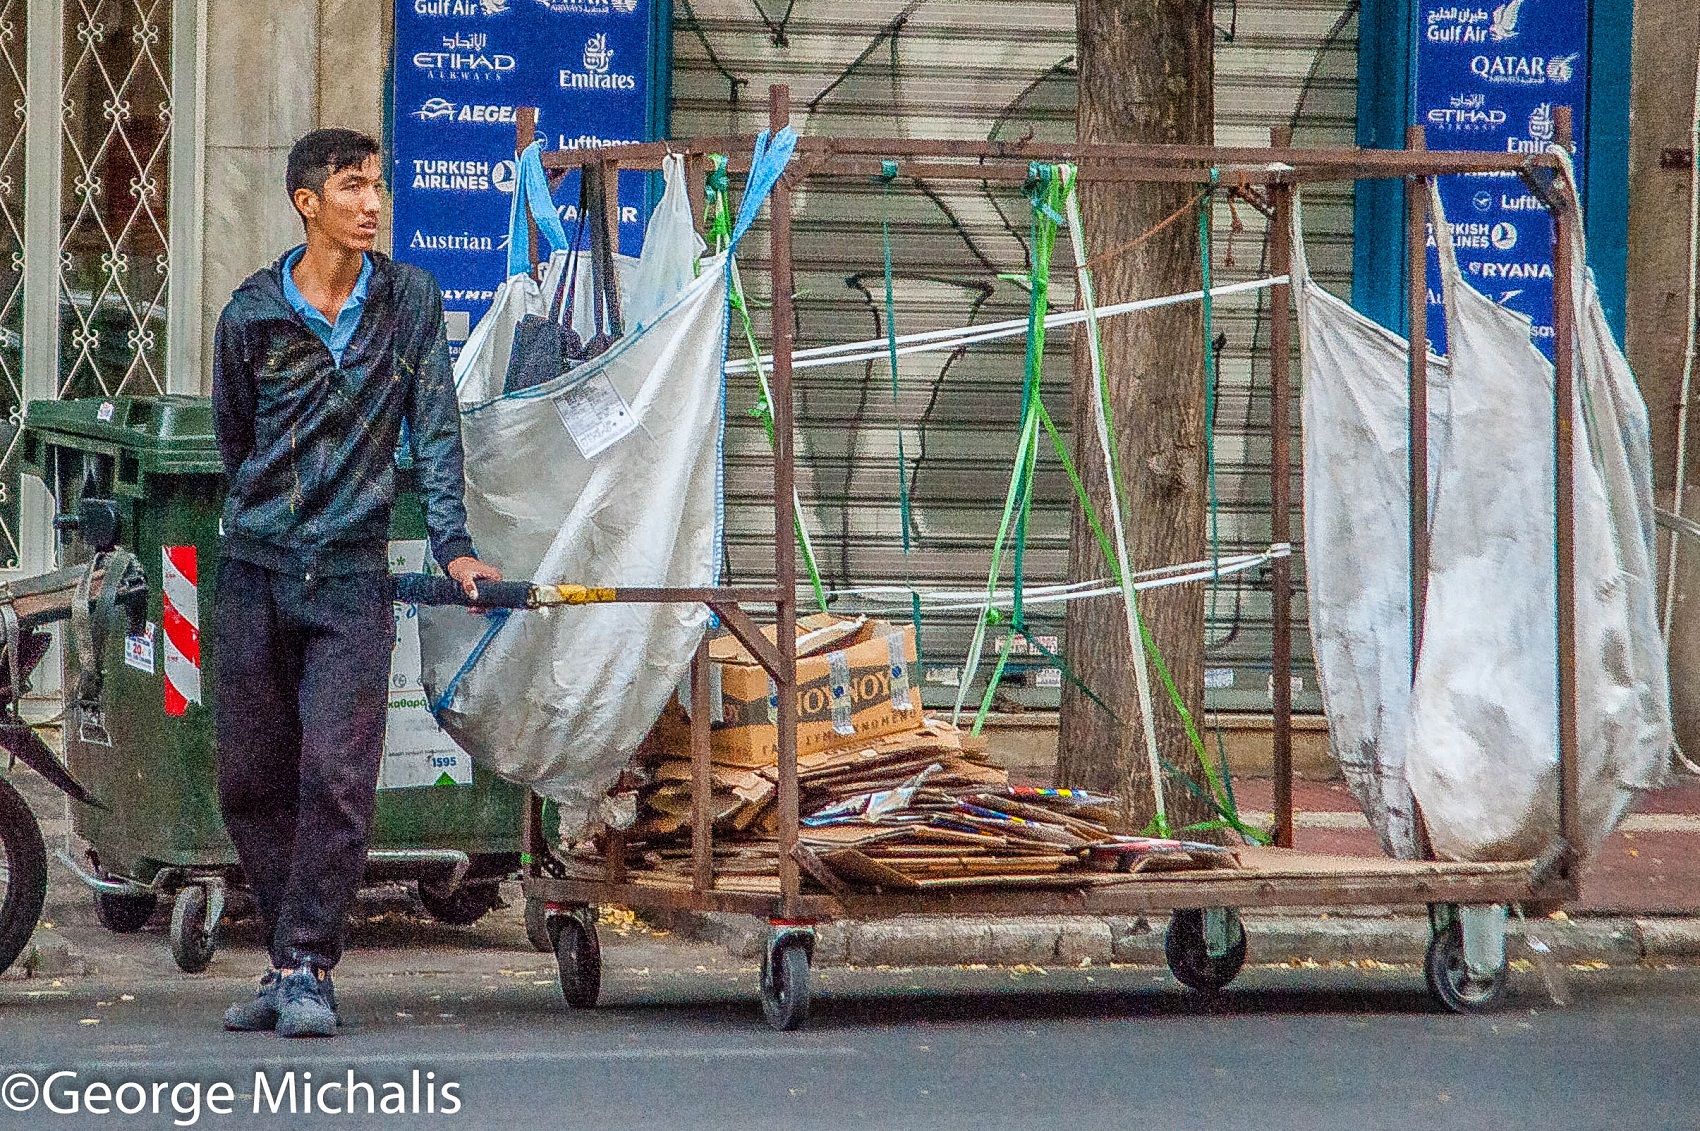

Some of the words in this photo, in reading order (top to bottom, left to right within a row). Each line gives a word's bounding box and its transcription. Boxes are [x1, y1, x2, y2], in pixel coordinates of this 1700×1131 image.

[414, 0, 450, 15] Gulf
[453, 0, 477, 15] Air
[1427, 25, 1461, 42] Gulf
[1464, 25, 1488, 42] Air
[413, 52, 516, 70] ETIHAD
[1470, 55, 1545, 78] QATAR
[427, 70, 501, 80] AIRWAYS
[559, 69, 635, 89] Emirates
[1428, 109, 1507, 123] ETIHAD
[413, 159, 488, 175] TURKISH
[412, 175, 489, 190] AIRLINES
[410, 229, 492, 250] Austrian
[1482, 262, 1554, 279] RYANA
[432, 757, 457, 768] 1595
